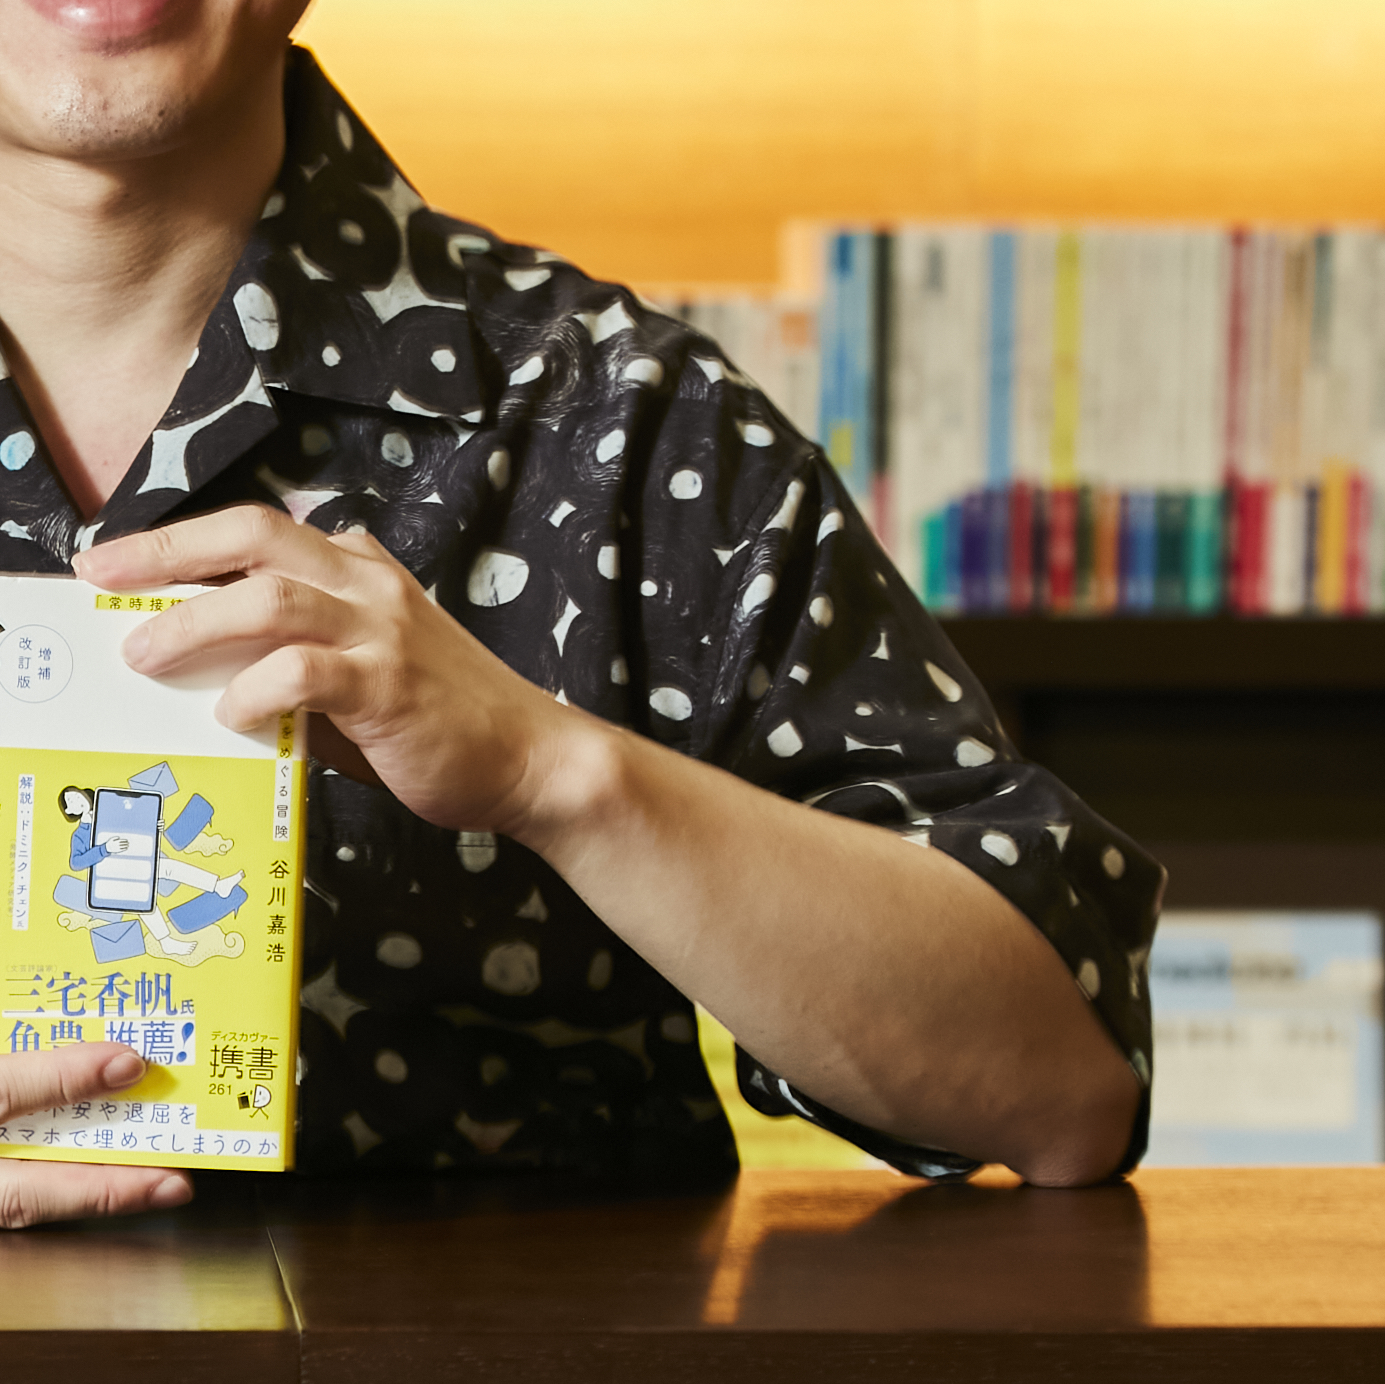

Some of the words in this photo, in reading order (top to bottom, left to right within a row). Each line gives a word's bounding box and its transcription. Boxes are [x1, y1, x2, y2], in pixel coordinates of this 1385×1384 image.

[16, 637, 33, 689] 改訂版
[38, 648, 52, 681] 増補
[266, 859, 290, 963] 谷川嘉浩
[4, 971, 195, 1017] 三宅香帆氏
[211, 1030, 280, 1043] ディスカヴァー
[210, 1044, 278, 1080] 携書
[208, 1083, 232, 1095] 261
